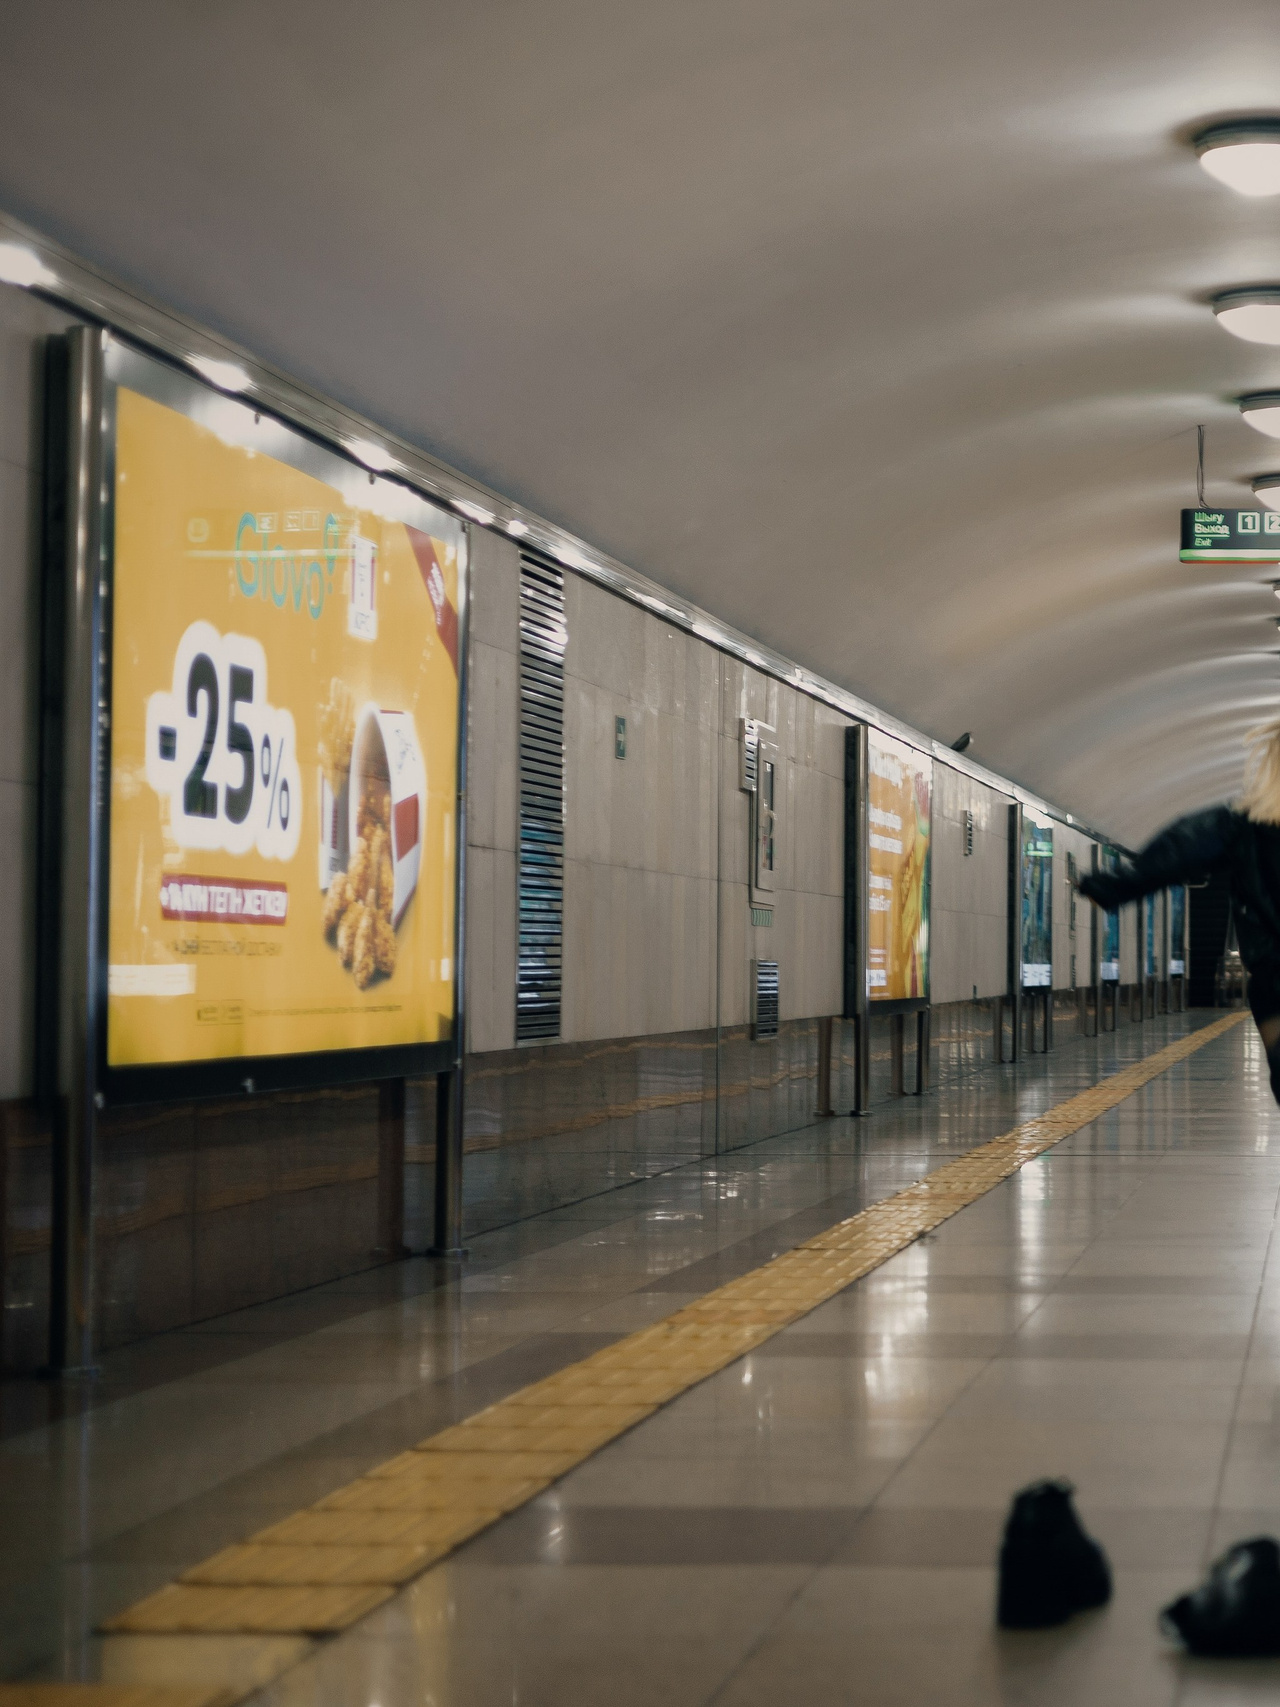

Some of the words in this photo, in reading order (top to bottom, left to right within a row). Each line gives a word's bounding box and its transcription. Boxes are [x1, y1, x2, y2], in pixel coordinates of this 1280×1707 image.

[1194, 523, 1230, 534] Выход
[1244, 516, 1253, 530] 1
[1269, 516, 1280, 530] 2
[1194, 537, 1212, 546] Exit
[158, 652, 290, 831] -25%
